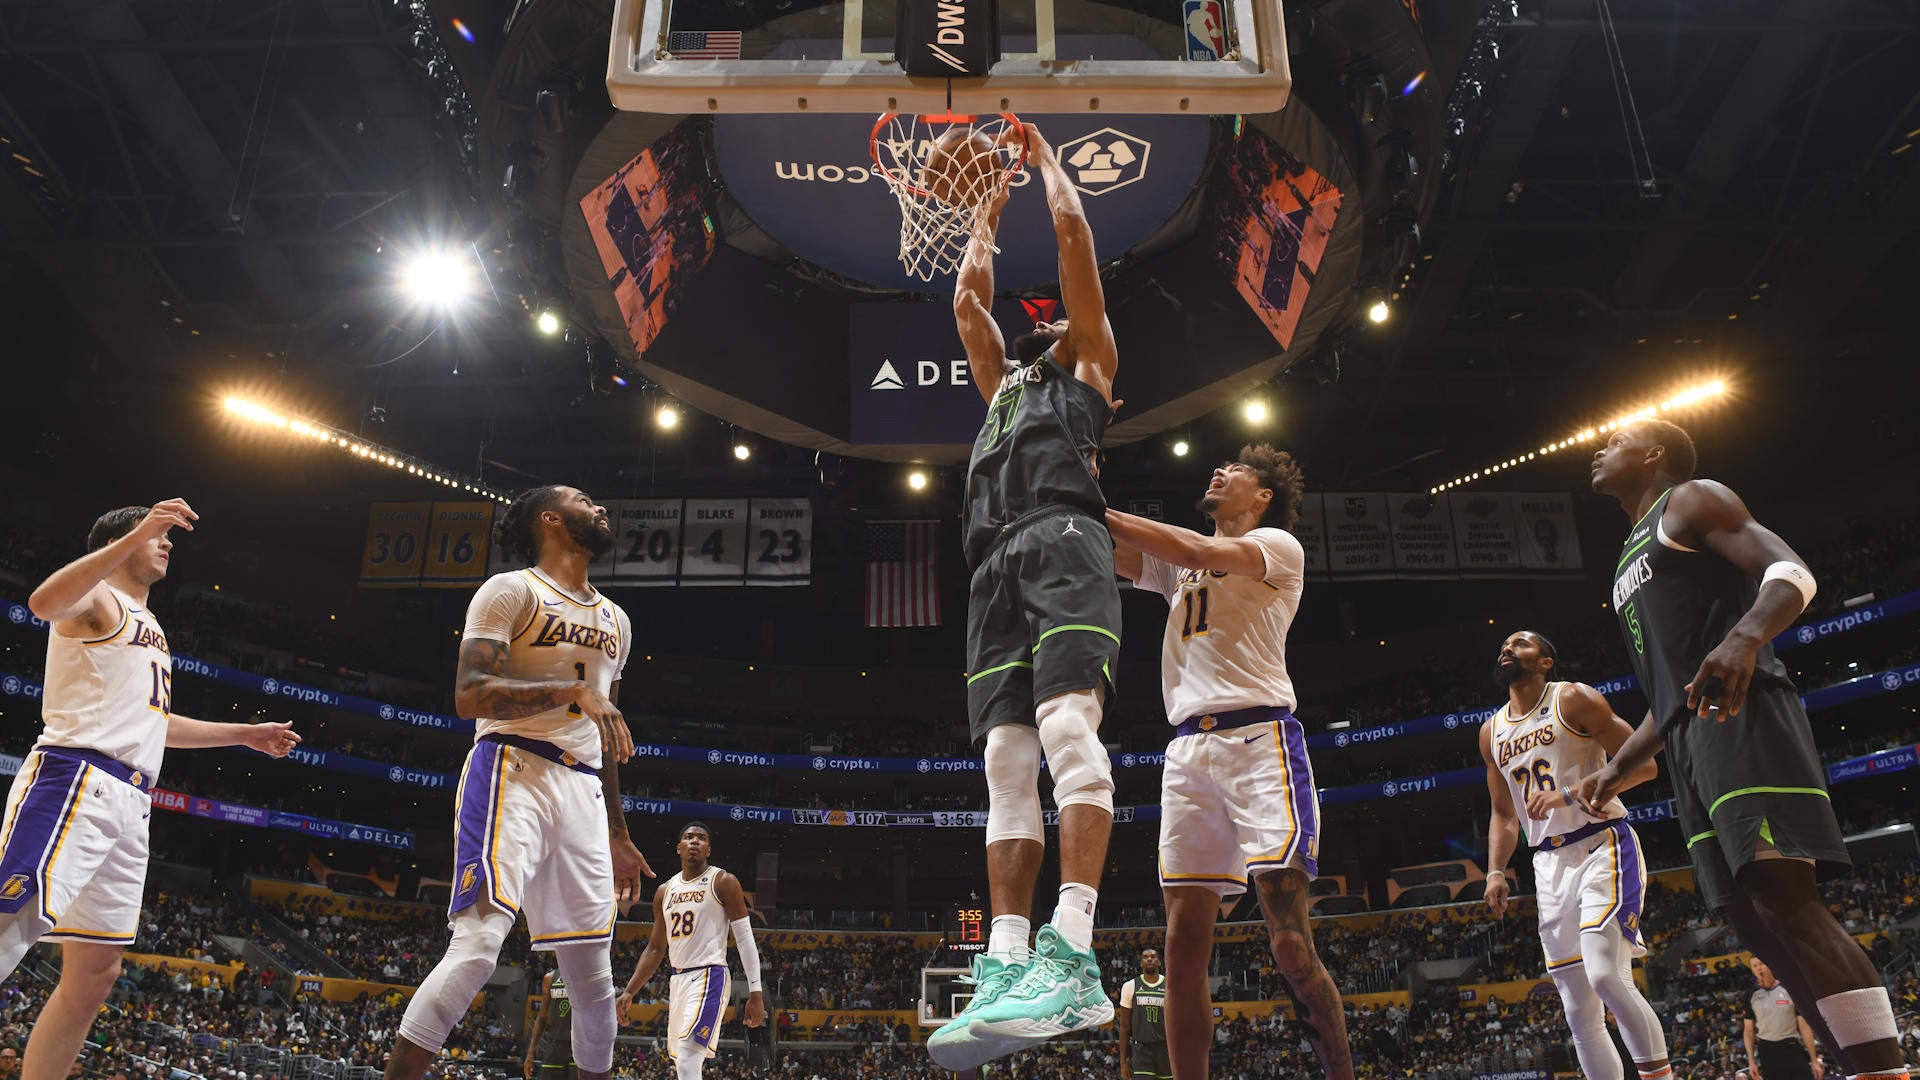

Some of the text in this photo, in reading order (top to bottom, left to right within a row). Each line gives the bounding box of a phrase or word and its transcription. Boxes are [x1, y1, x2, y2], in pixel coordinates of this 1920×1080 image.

[937, 0, 966, 45] DW
[1192, 50, 1212, 61] NBA
[439, 511, 484, 521] DIONNE
[620, 509, 680, 520] ROBITAILLE
[697, 508, 736, 520] BLAKE
[760, 508, 804, 520] BROWN
[370, 531, 418, 566] 30
[438, 531, 475, 565] 16
[623, 528, 673, 563] 20
[702, 528, 725, 562] 4
[757, 528, 802, 564] 23
[1181, 585, 1209, 642] 11
[1818, 607, 1884, 635] crypto.
[529, 613, 619, 661] LAKERS
[1624, 602, 1644, 654] 5
[127, 618, 171, 657] LAKE
[148, 660, 171, 720] 15
[282, 684, 339, 705] crypto.
[567, 660, 586, 719] 1
[397, 709, 452, 728] crypto.
[1352, 725, 1404, 742] crypto.
[1498, 724, 1556, 768] LAKERS
[725, 752, 775, 766] crypto.
[829, 758, 880, 771] crypto.
[1875, 753, 1914, 768] ULTRA
[1510, 758, 1556, 804] 26
[799, 815, 805, 823] 3
[858, 813, 883, 825] 107
[897, 815, 925, 824] Lakers
[940, 812, 974, 826] 3:56
[1123, 813, 1129, 821] 3
[1626, 806, 1665, 821] ELTA
[309, 821, 340, 834] ULTRA
[364, 829, 409, 847] DELTA
[665, 890, 706, 910] LAKERS
[670, 910, 695, 938] 28
[957, 909, 982, 921] 3:55
[961, 921, 981, 941] 13
[303, 981, 320, 991] 114
[559, 1000, 571, 1018] 9
[1145, 1005, 1158, 1023] 11
[1492, 1071, 1538, 1080] CHAMPIONS
